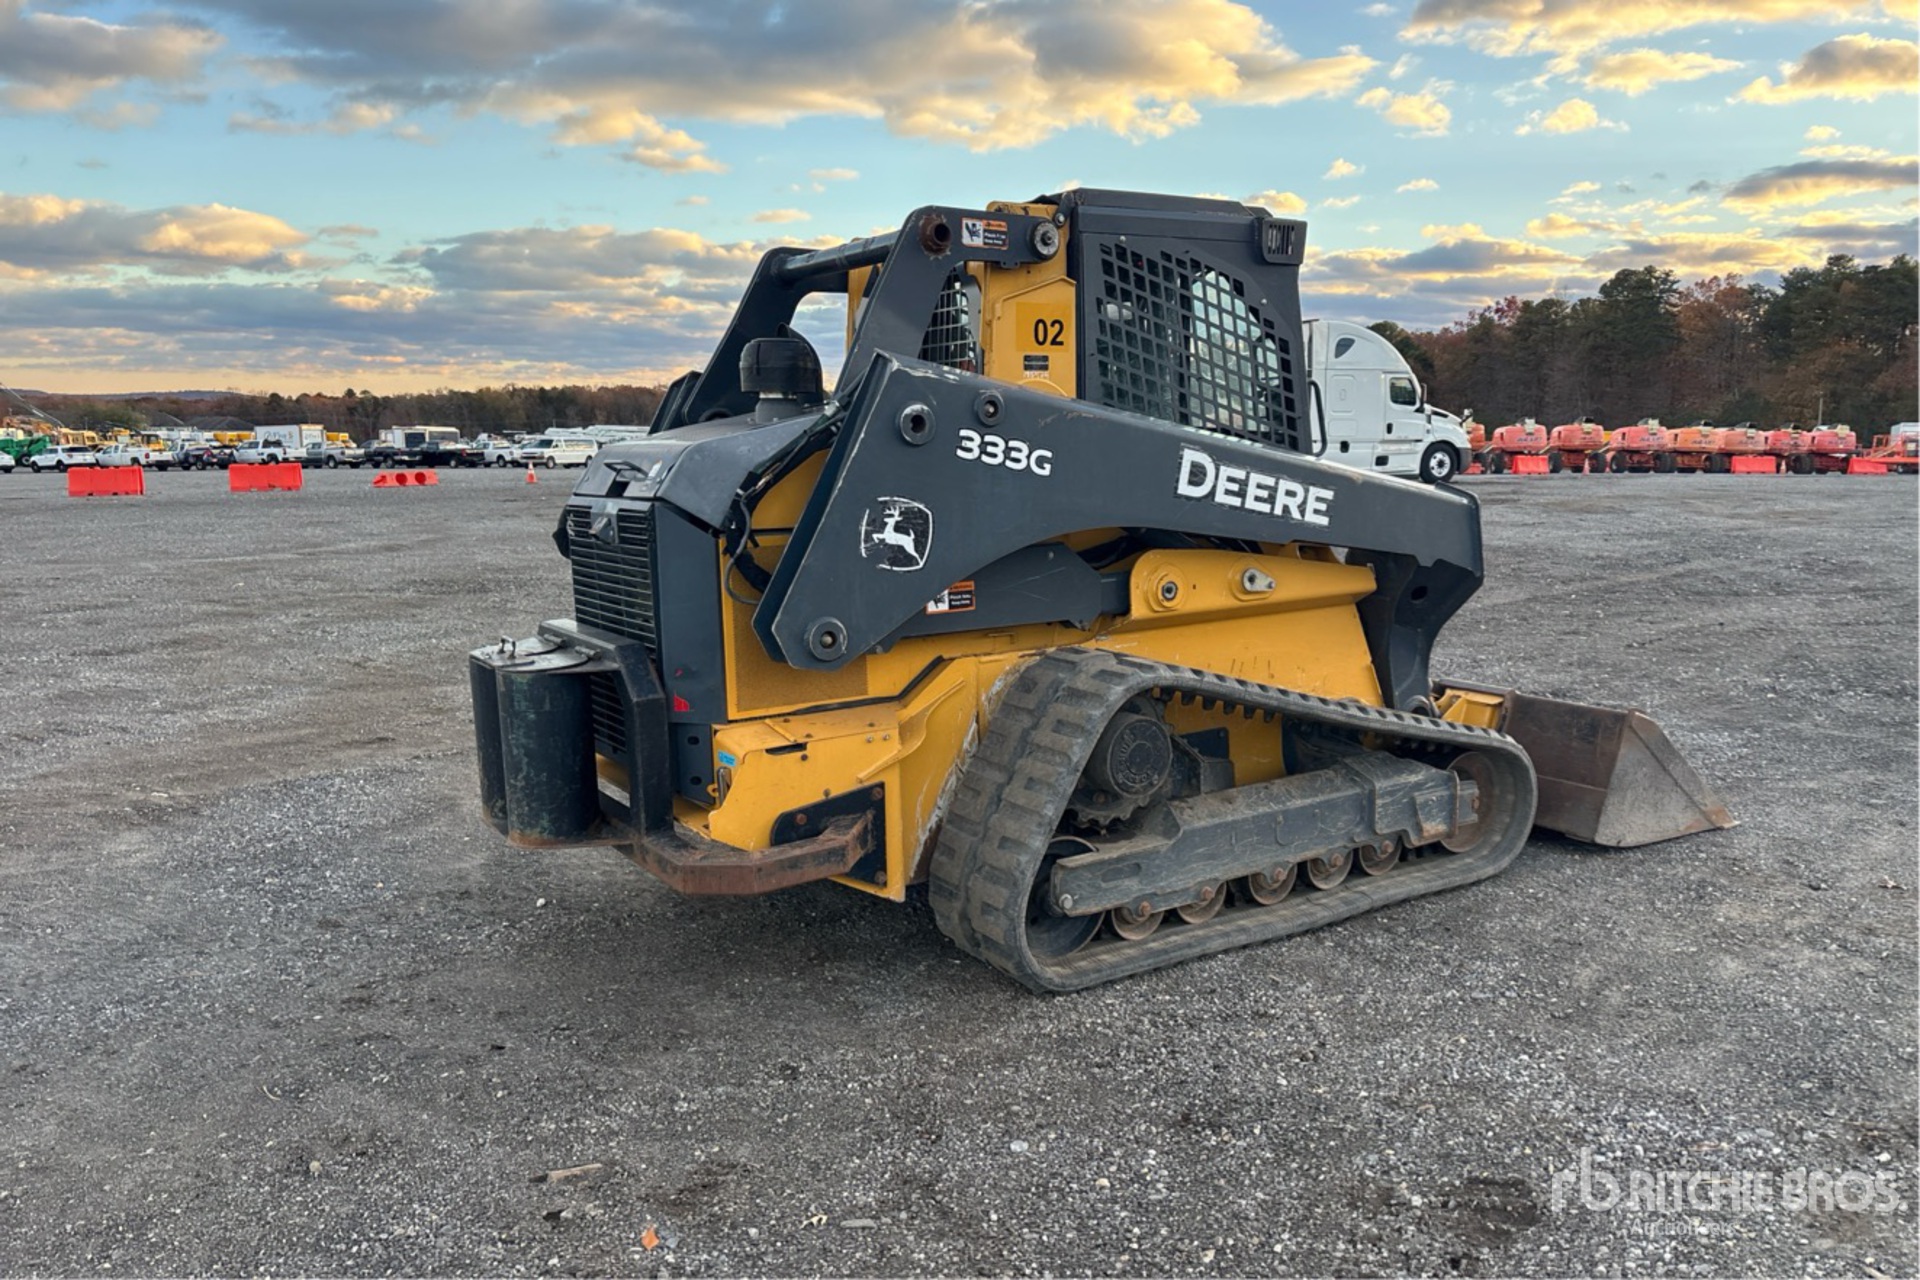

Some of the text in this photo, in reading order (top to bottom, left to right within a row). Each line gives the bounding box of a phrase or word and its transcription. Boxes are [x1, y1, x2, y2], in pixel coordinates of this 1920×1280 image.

[1033, 318, 1064, 346] 02
[956, 428, 1053, 476] 333G
[1177, 448, 1334, 526] DEERE
